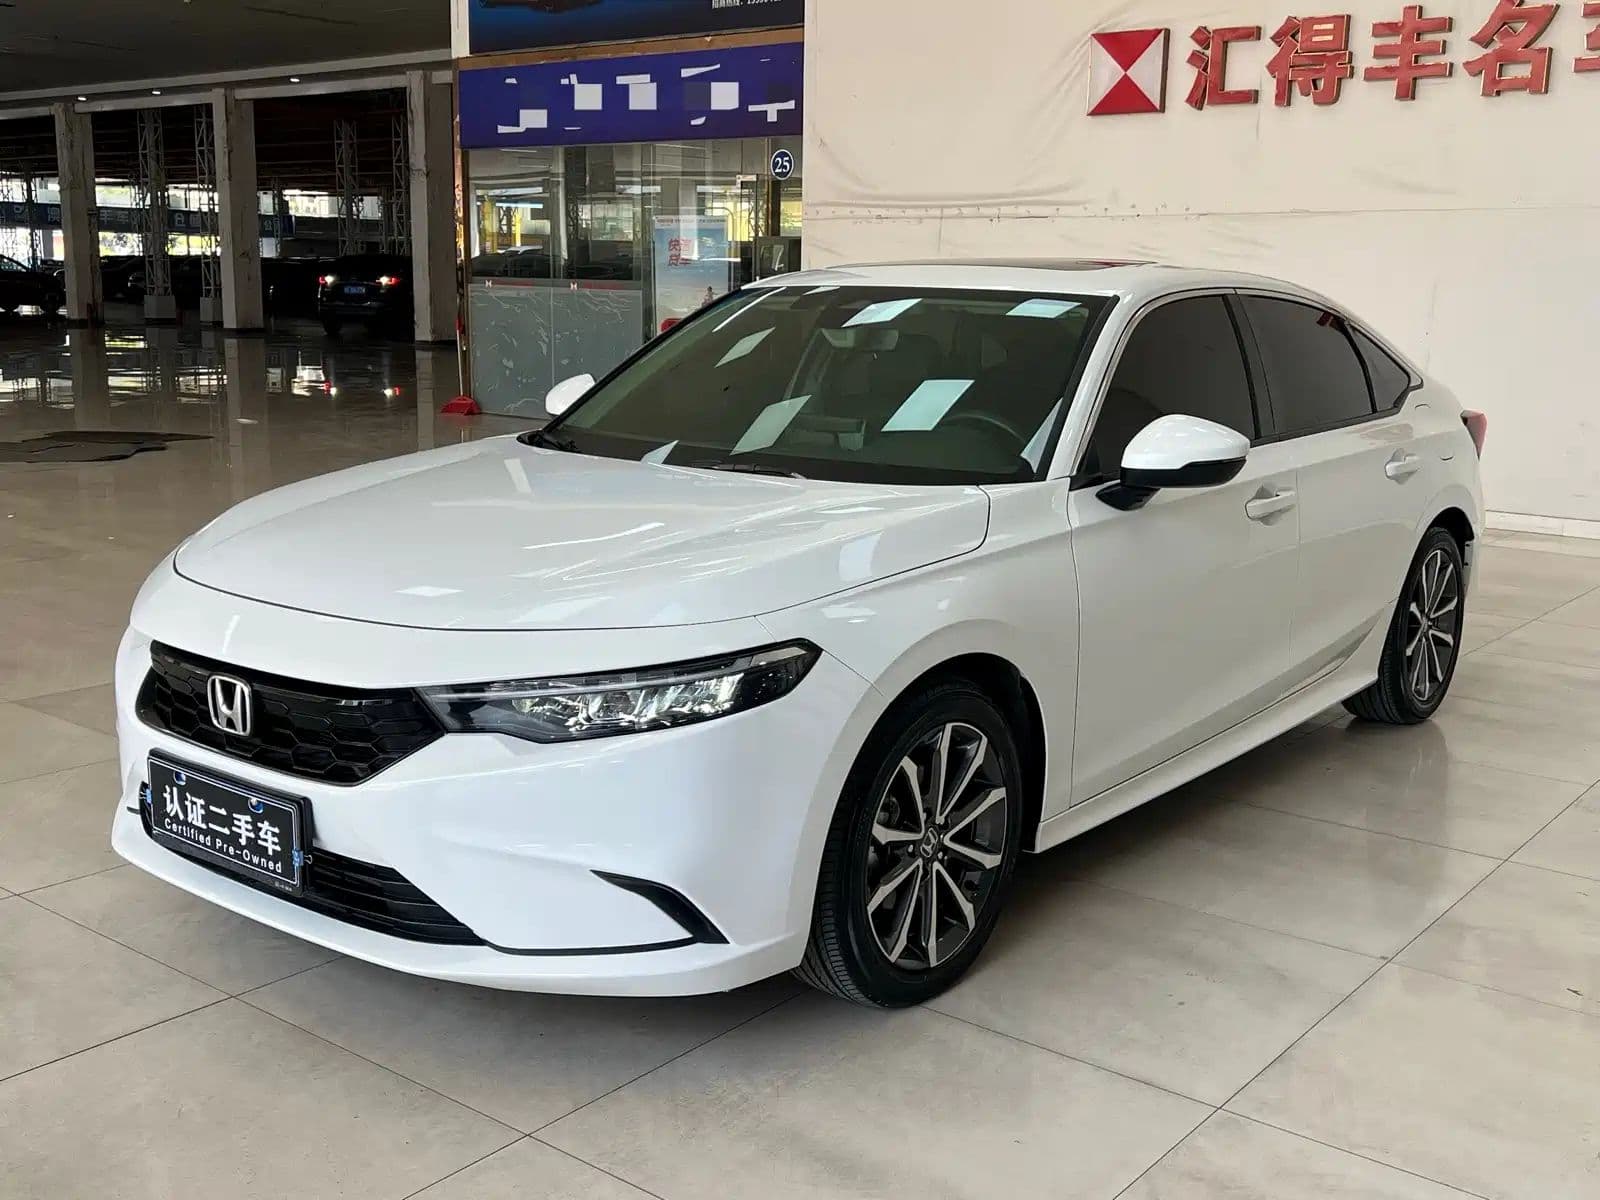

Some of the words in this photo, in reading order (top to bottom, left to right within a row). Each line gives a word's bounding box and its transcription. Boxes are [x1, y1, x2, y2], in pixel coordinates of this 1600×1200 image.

[774, 157, 790, 174] 25
[163, 785, 281, 855] 认证二手车
[164, 818, 211, 846] Certified
[215, 838, 282, 873] Pre-Owned
